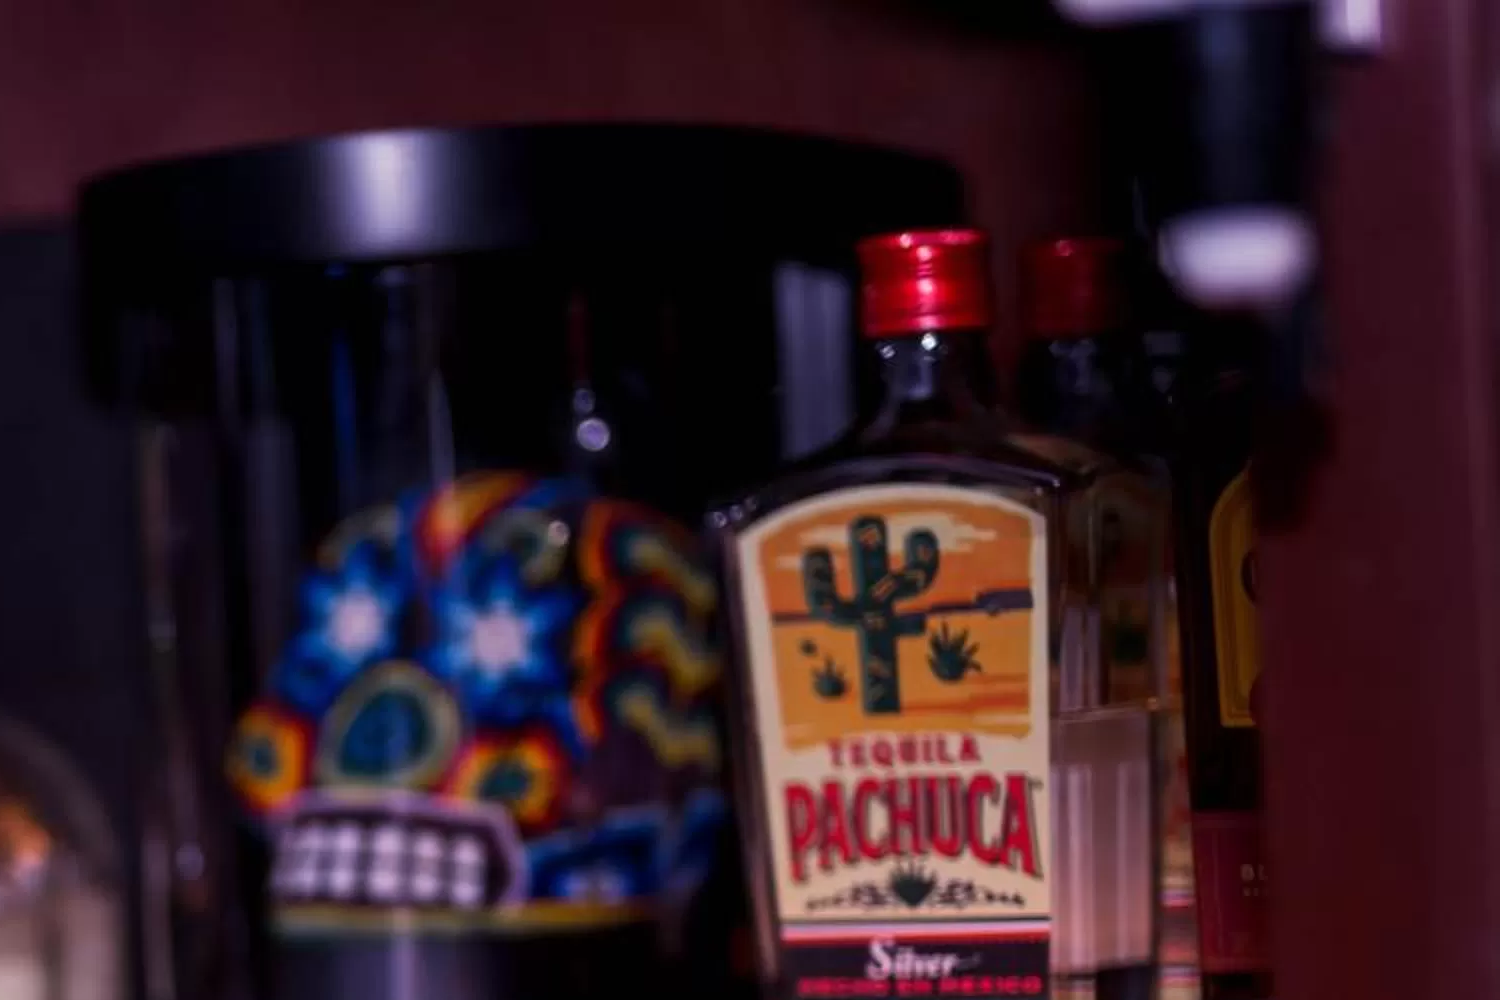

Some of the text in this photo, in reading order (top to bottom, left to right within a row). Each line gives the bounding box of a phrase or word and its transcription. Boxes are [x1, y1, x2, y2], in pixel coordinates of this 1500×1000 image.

[827, 733, 981, 769] TEQUILA
[784, 770, 1045, 885] PACHUCA
[865, 936, 960, 981] Silver
